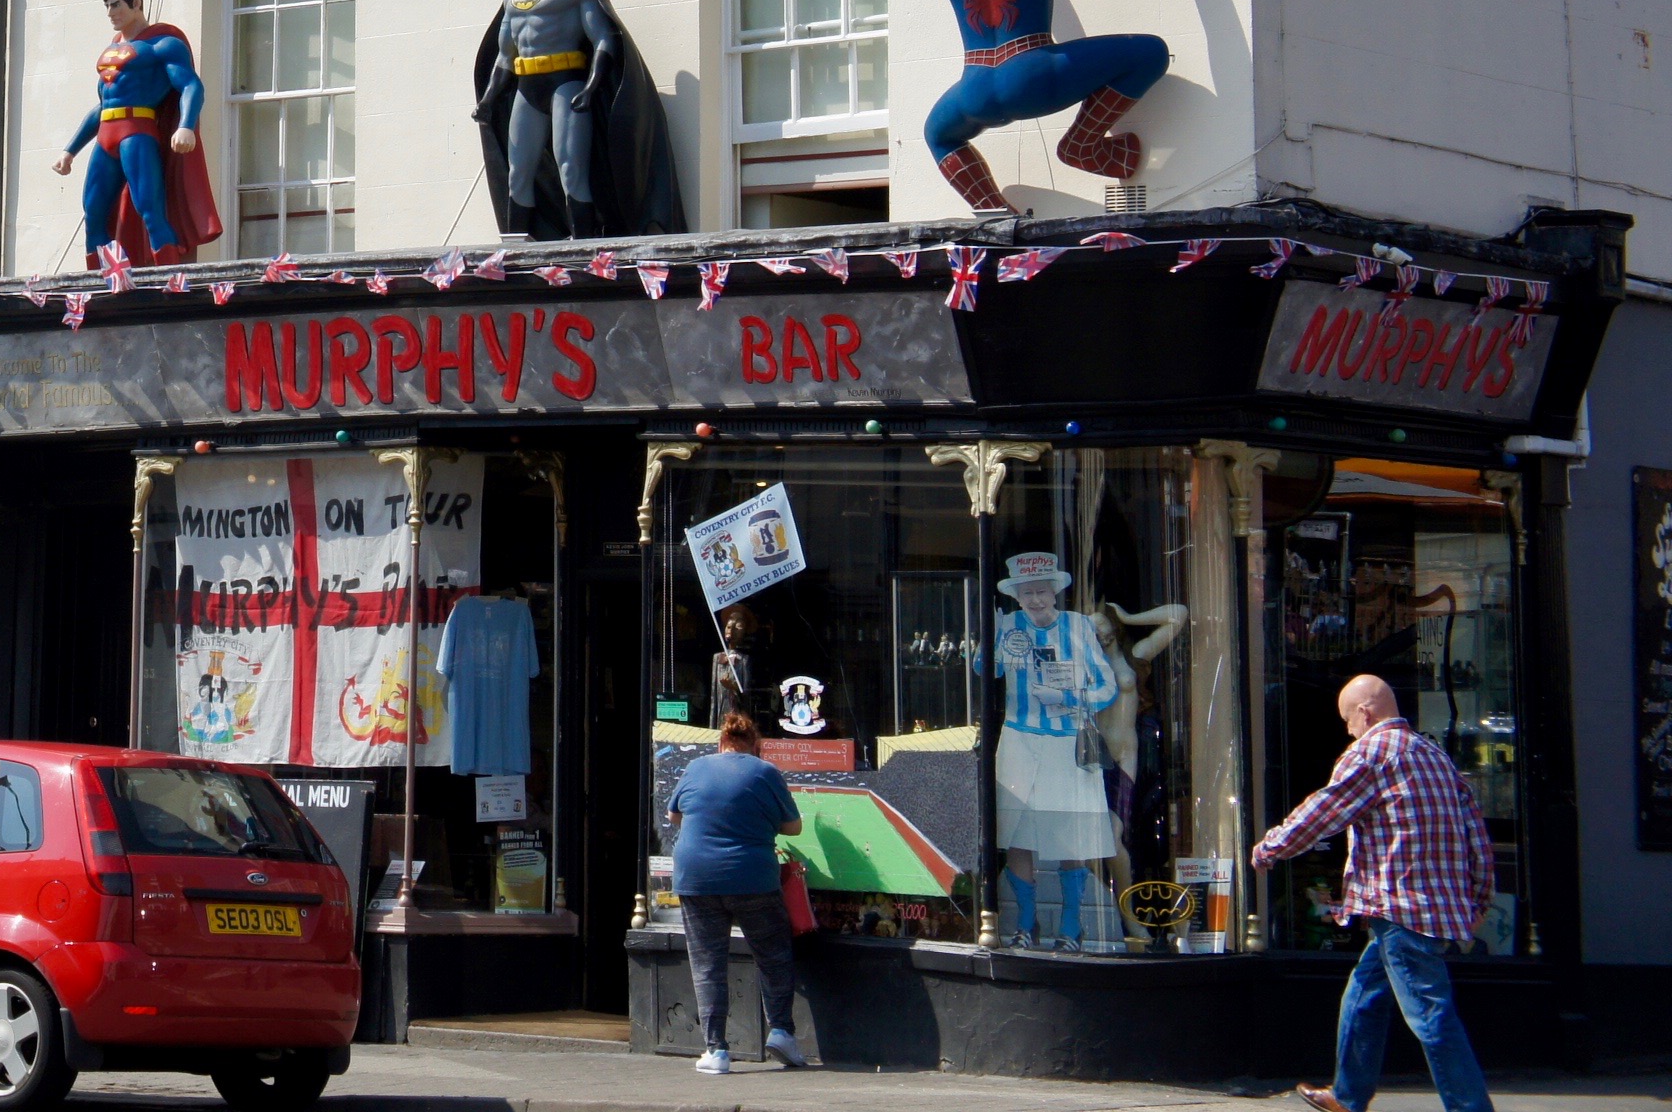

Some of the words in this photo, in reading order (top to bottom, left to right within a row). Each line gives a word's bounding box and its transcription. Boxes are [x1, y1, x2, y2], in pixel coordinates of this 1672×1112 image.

[47, 353, 67, 374] To
[72, 351, 101, 373] The
[224, 308, 597, 413] MURPHY'S
[738, 314, 861, 384] BAR
[325, 498, 365, 535] ON
[695, 512, 739, 539] COVENTRY
[741, 500, 759, 516] CITY
[1016, 556, 1054, 566] Murphy's
[716, 588, 738, 605] PLAY
[740, 581, 752, 593] UP
[753, 573, 771, 588] SKY
[773, 559, 800, 579] BLUES
[185, 636, 228, 649] COVENTRY
[763, 741, 795, 750] COVENTRY
[797, 743, 812, 751] CITY
[841, 743, 848, 754] 3
[763, 753, 791, 761] EXETER
[793, 754, 809, 762] CITY
[308, 786, 351, 808] MENU
[1211, 871, 1228, 880] ALL
[215, 908, 260, 930] SE03
[264, 910, 294, 932] OSL
